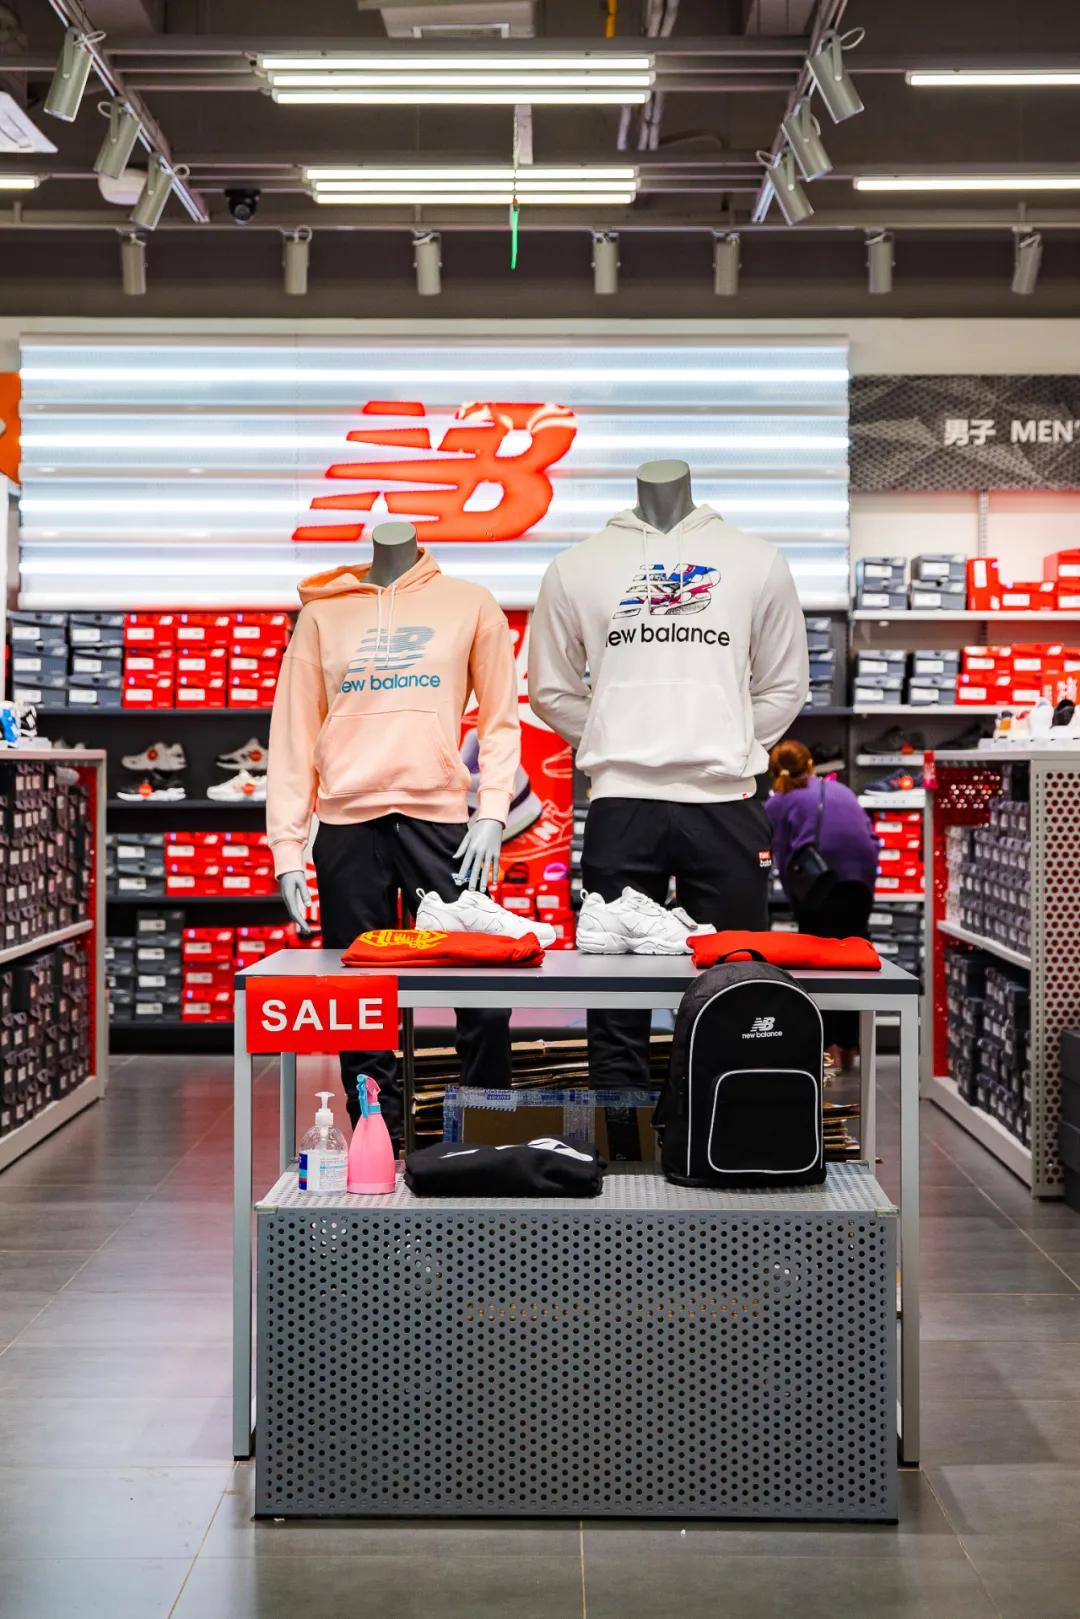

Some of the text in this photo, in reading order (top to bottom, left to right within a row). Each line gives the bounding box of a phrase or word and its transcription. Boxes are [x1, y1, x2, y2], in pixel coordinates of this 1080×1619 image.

[943, 418, 997, 446] 男子
[605, 623, 730, 647] ew balance
[339, 673, 441, 693] ew balance
[260, 997, 384, 1032] SALE
